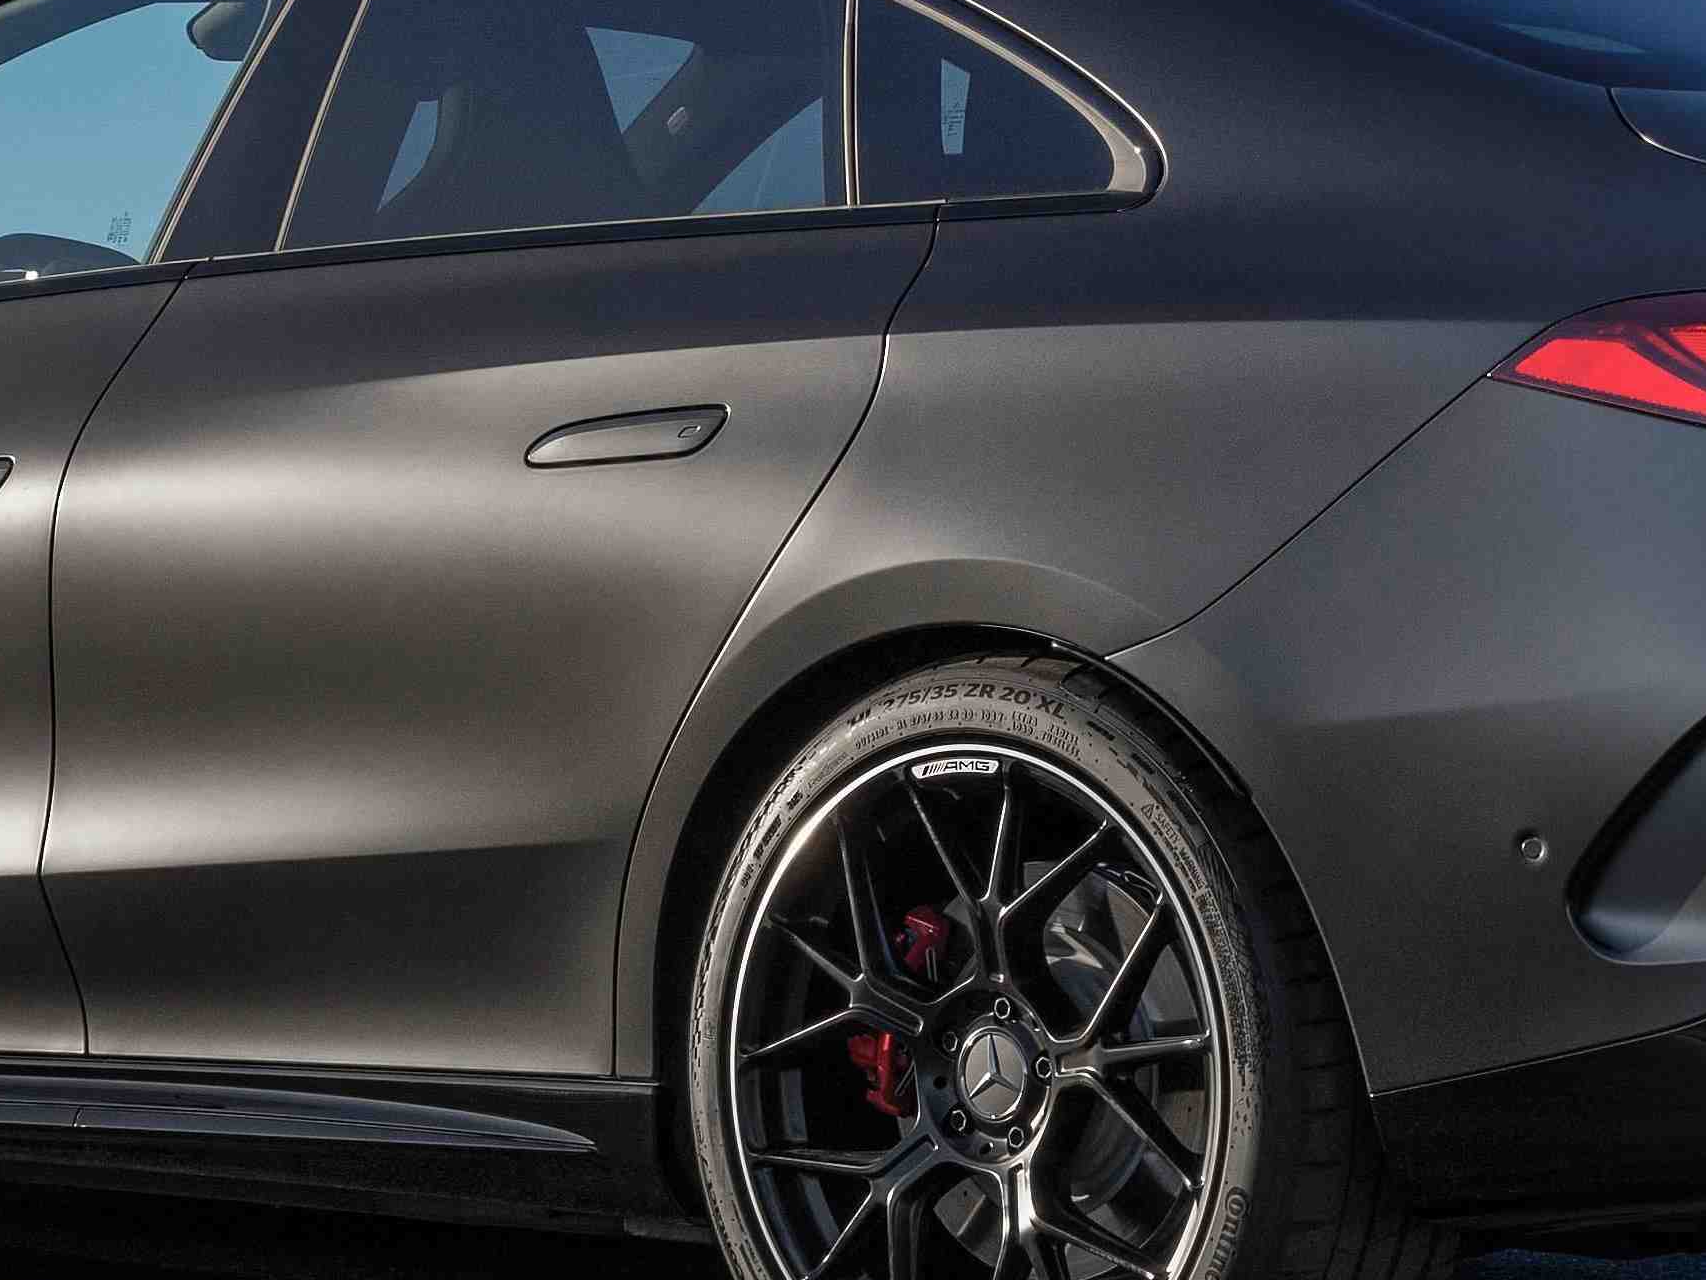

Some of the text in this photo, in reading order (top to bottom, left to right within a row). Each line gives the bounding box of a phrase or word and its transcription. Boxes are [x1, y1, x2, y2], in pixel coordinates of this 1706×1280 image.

[963, 683, 995, 699] ZR
[999, 687, 1031, 705] 20
[942, 760, 991, 772] AMG
